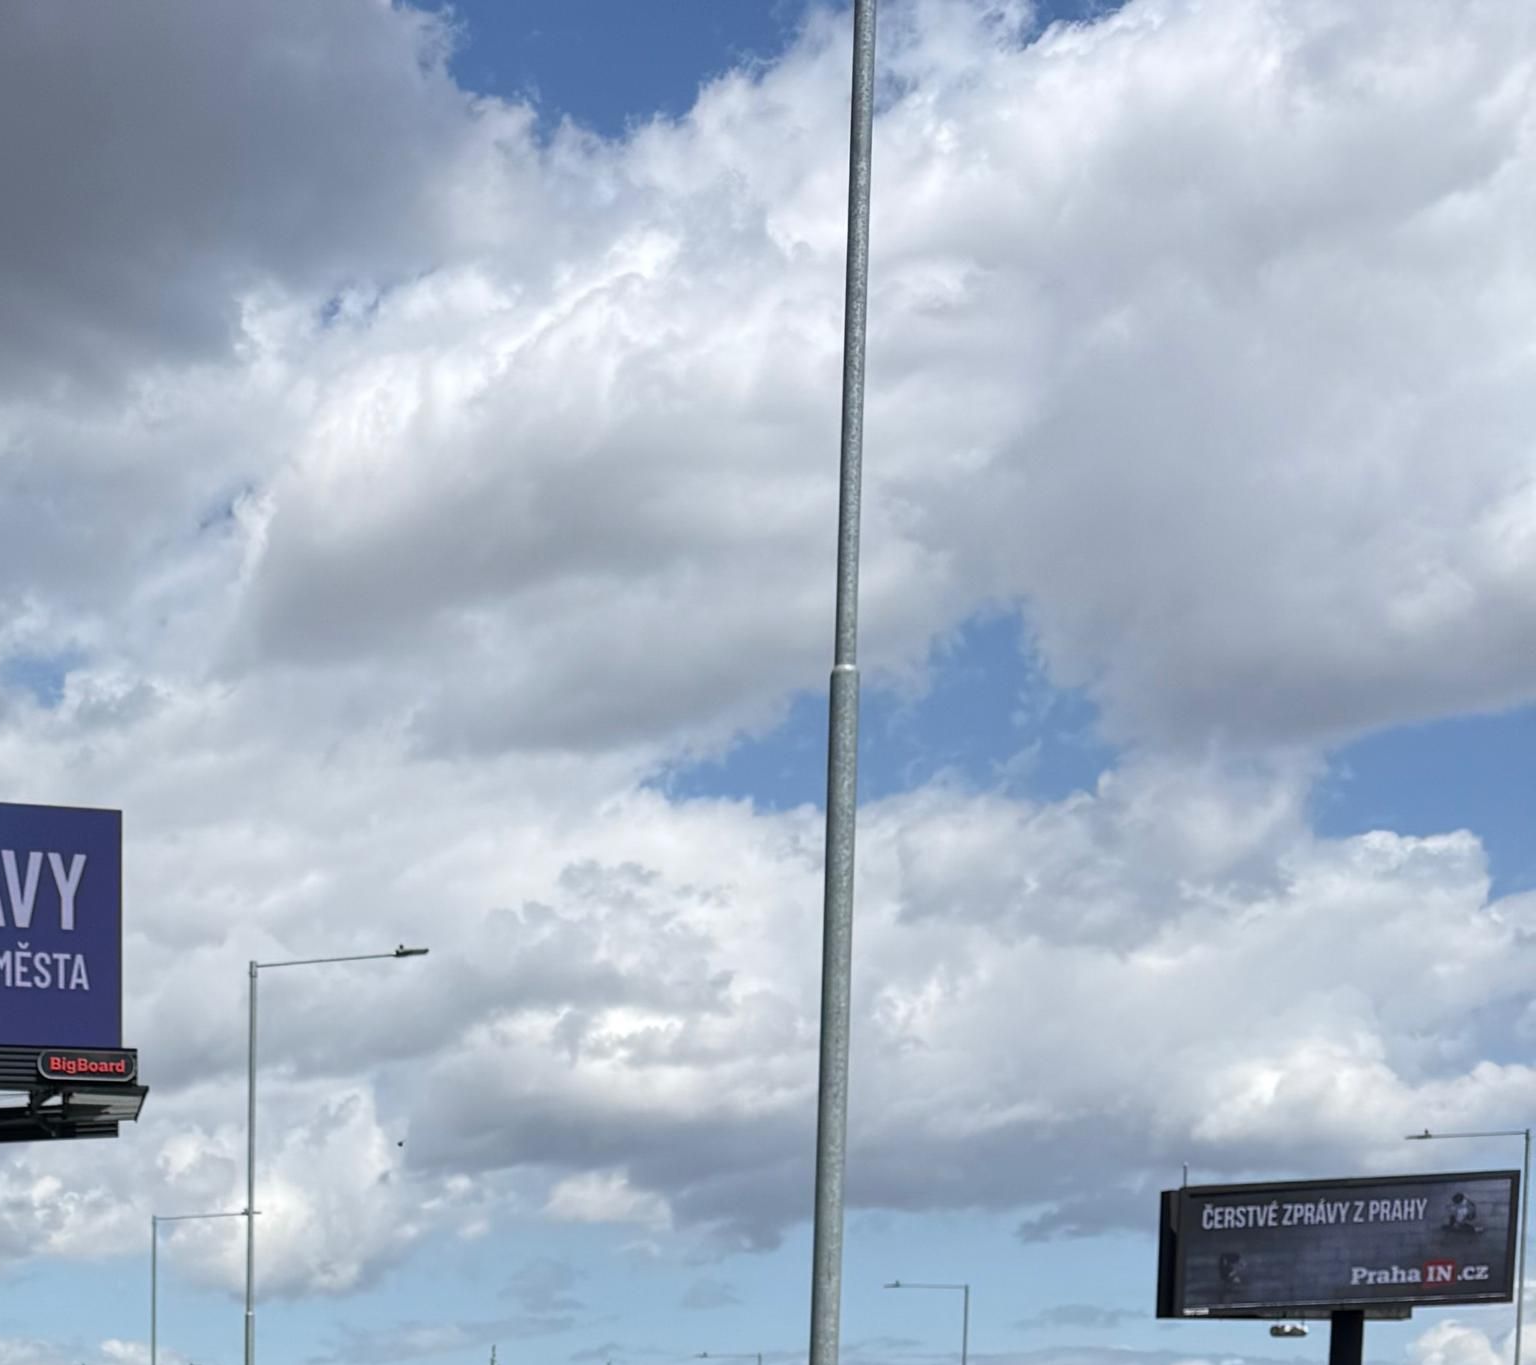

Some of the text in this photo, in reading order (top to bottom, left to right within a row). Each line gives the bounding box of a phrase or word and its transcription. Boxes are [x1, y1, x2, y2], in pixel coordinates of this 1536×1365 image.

[49, 1056, 126, 1075] BigBoard
[1201, 1197, 1428, 1230] ČERSTVÉ ZPRÁVY Z PRAHY
